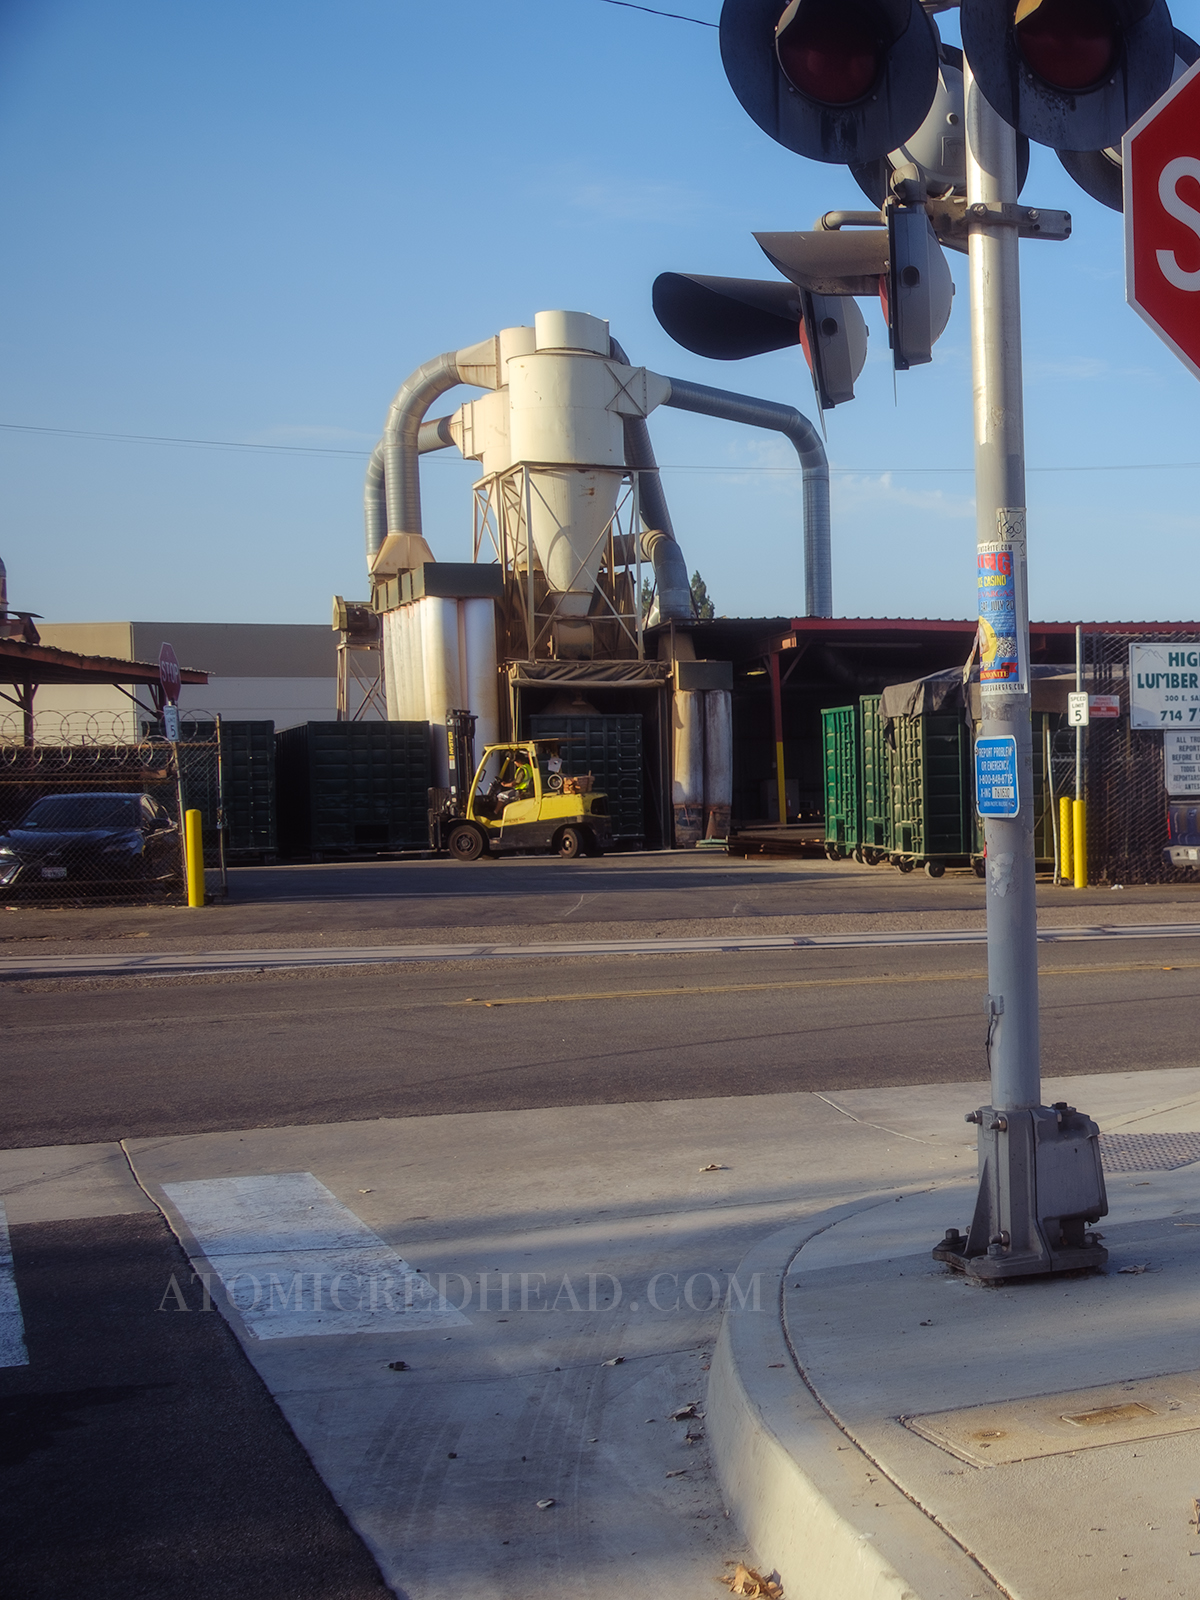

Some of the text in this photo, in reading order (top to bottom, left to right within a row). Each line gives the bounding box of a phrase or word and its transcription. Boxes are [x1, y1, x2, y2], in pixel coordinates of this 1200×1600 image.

[984, 575, 1007, 588] CASINO
[982, 590, 1014, 598] VARGAS
[161, 661, 178, 683] STOP
[1137, 673, 1198, 689] LUMBER
[1075, 709, 1082, 722] 5
[1160, 710, 1183, 721] 714
[171, 725, 176, 738] 5
[979, 746, 1012, 757] REPORT PROBLEM
[981, 761, 987, 771] OR
